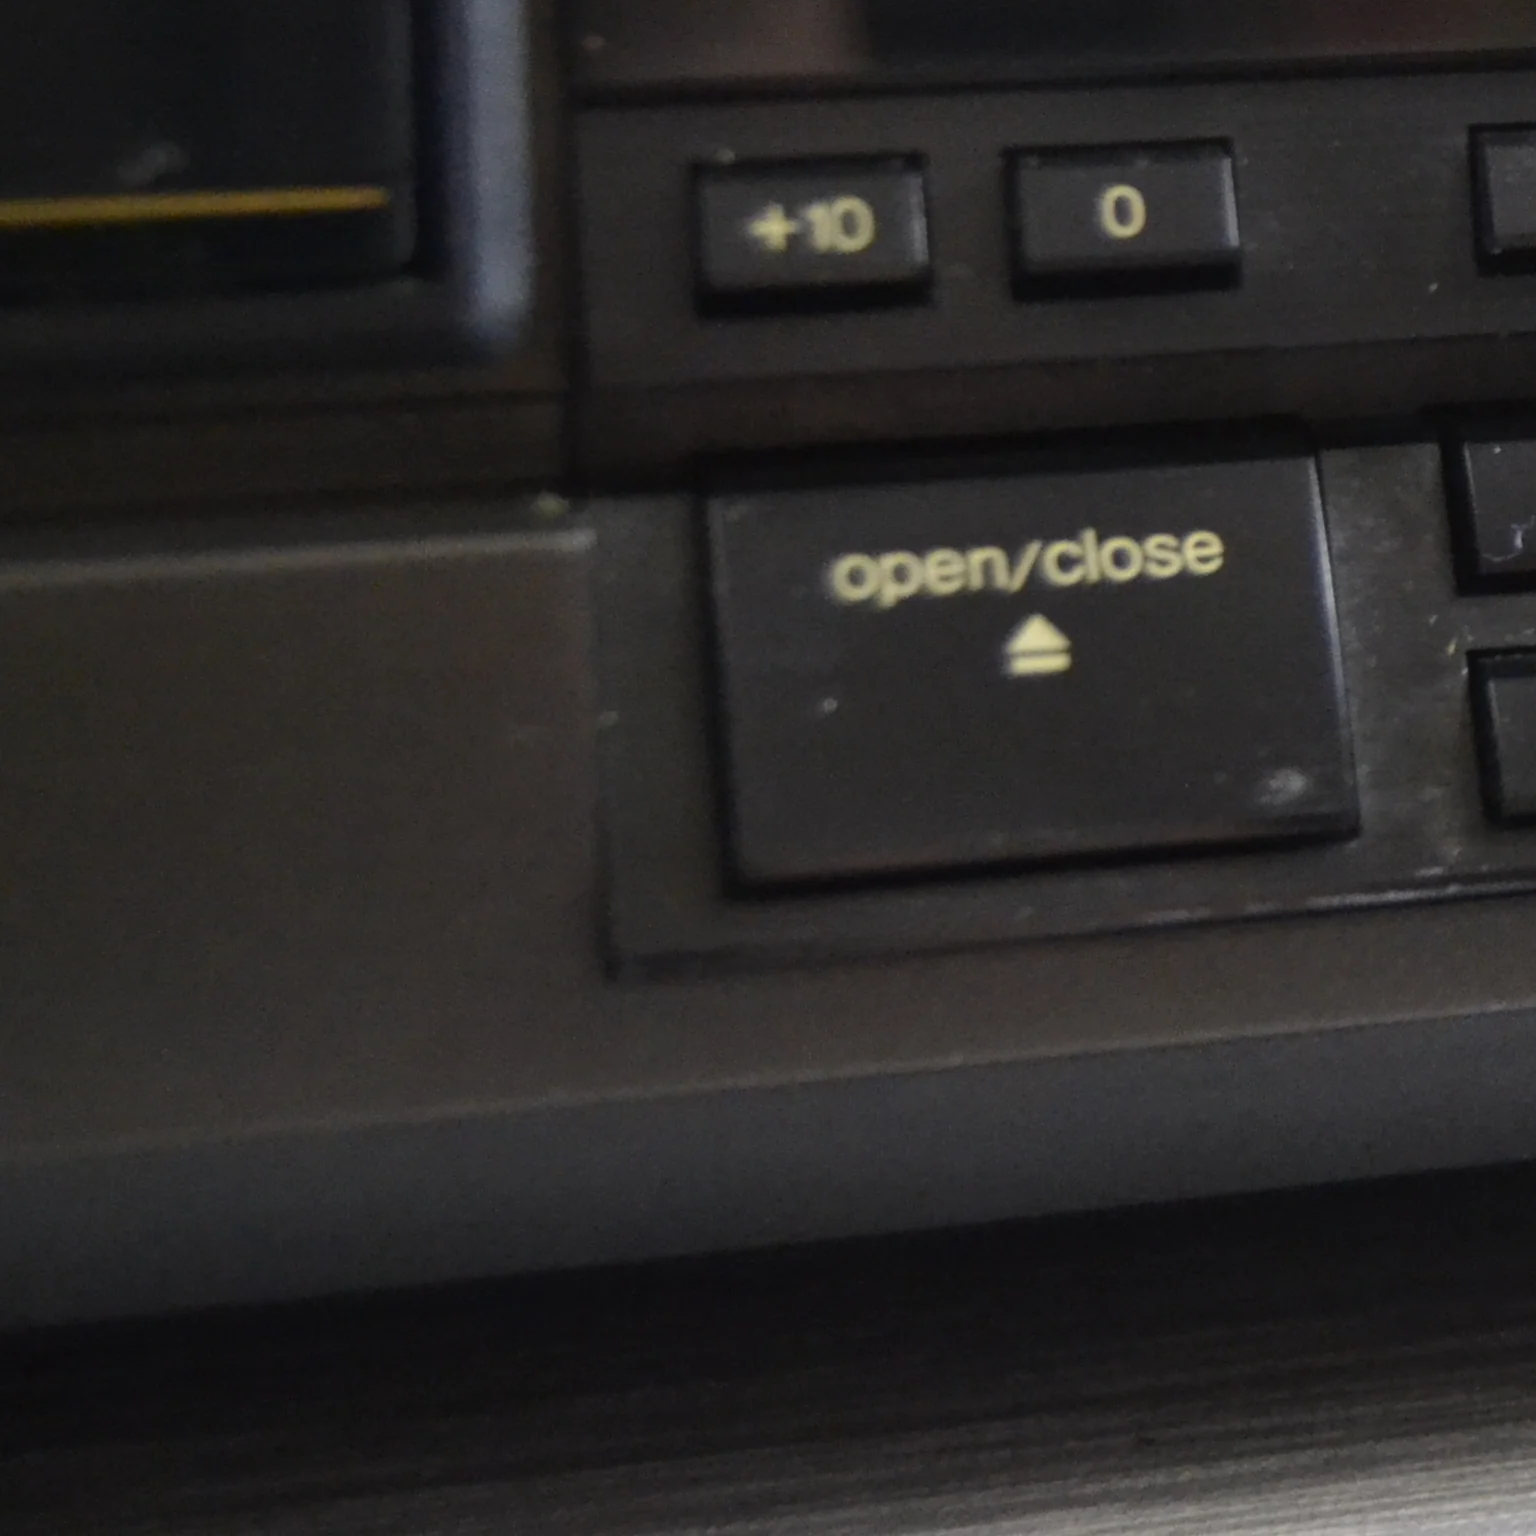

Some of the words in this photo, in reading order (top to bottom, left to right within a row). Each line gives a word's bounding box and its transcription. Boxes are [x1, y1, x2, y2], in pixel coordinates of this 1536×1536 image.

[747, 196, 875, 253] +10
[1098, 184, 1146, 239] 0
[827, 528, 1225, 608] open/close
